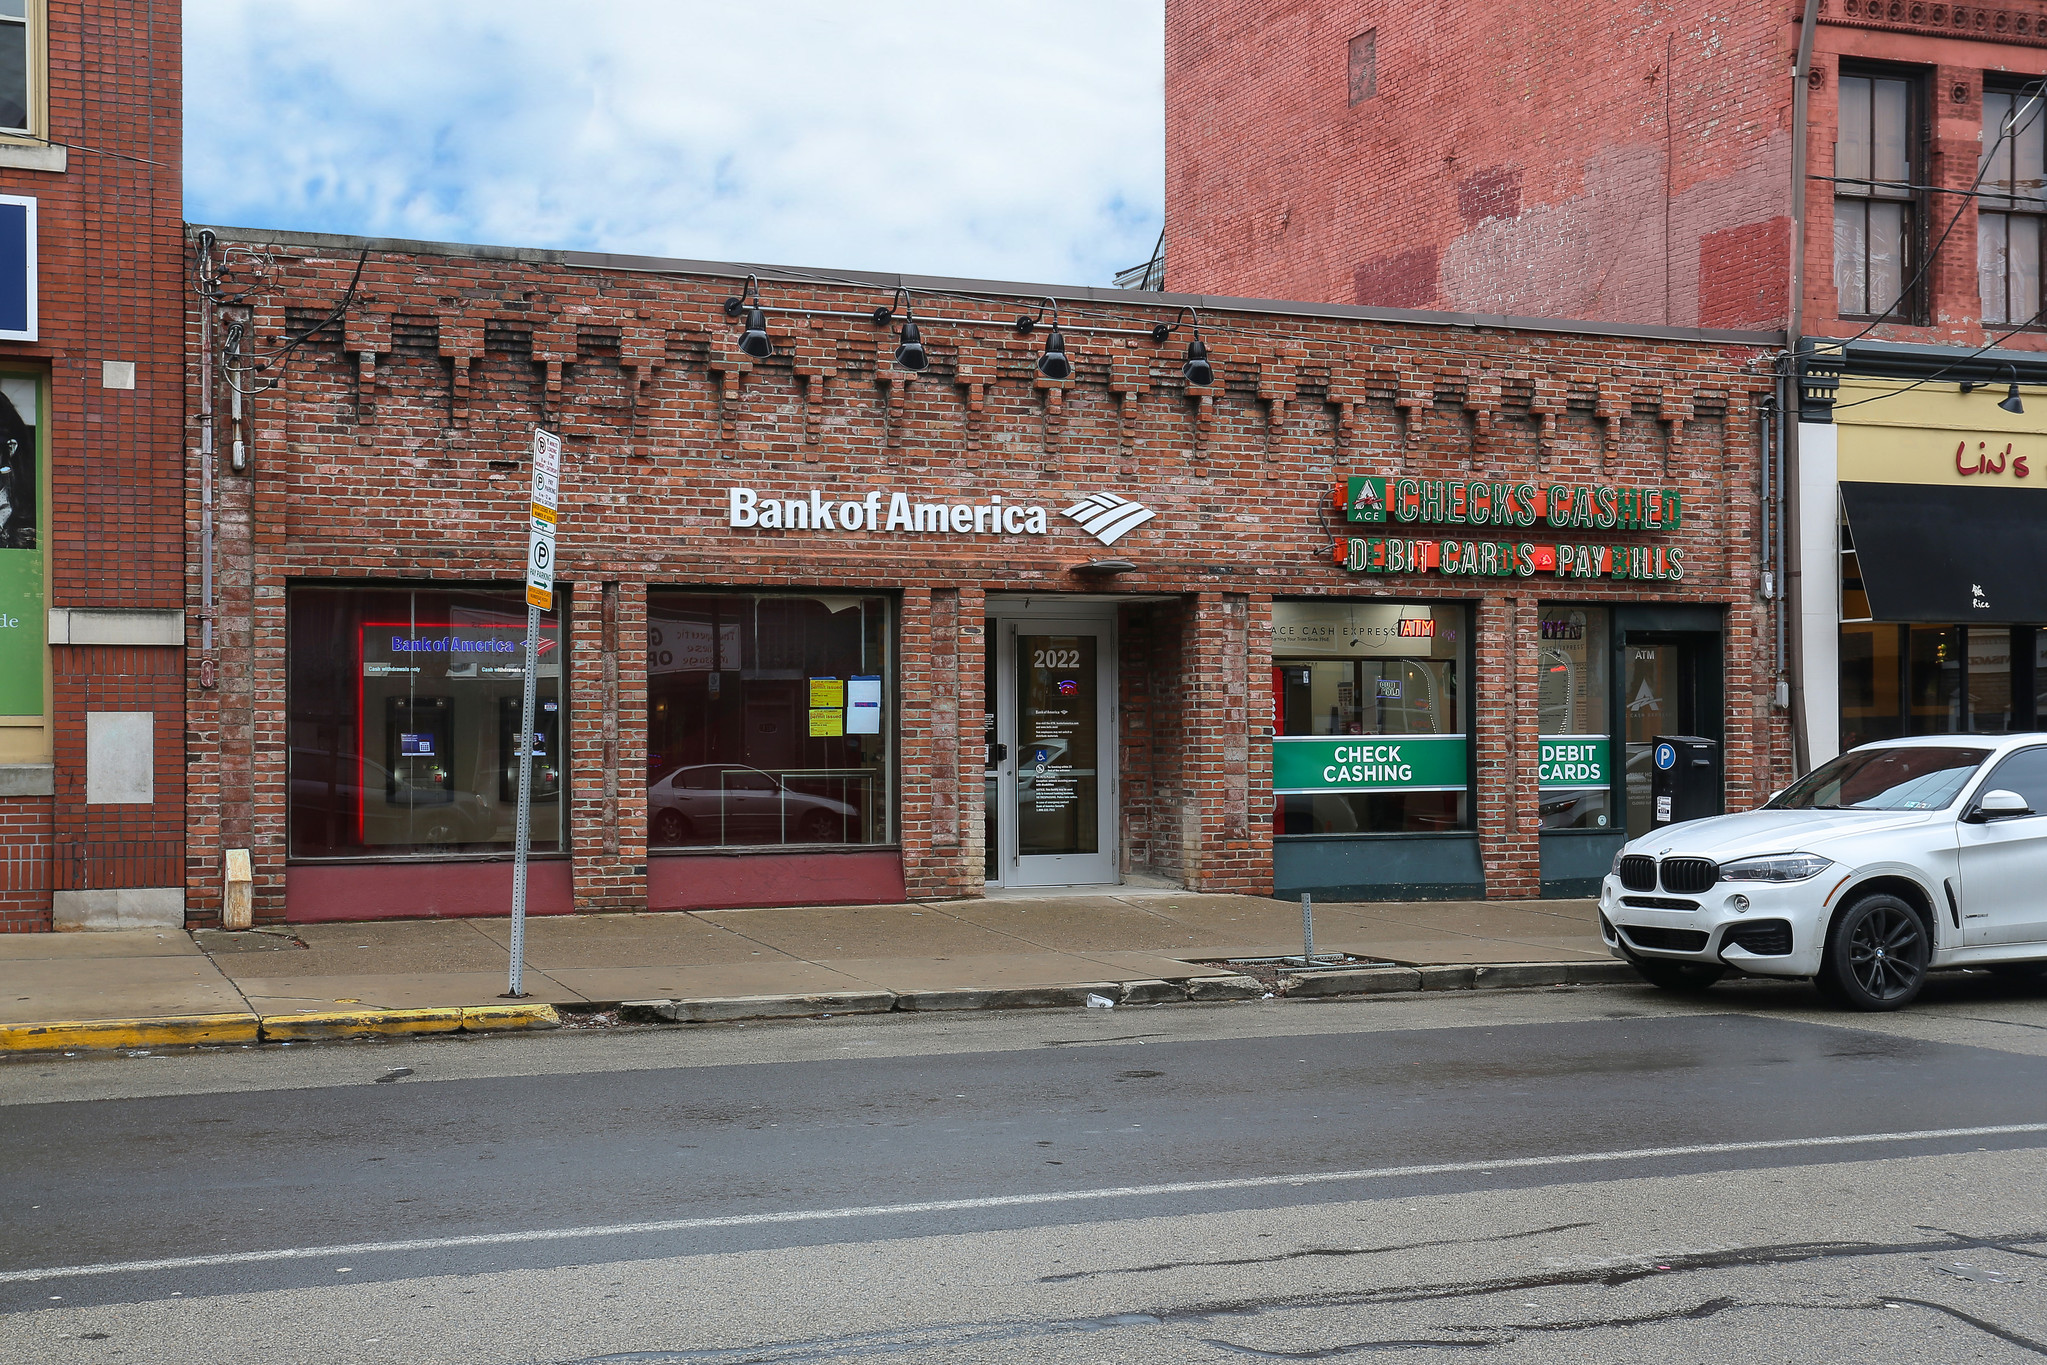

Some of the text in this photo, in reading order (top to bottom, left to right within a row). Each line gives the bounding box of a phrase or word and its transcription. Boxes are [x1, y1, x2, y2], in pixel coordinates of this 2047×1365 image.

[729, 487, 1047, 535] Bank of America
[1395, 478, 1682, 531] CHECKS CASHED
[1355, 511, 1380, 521] ACE
[1347, 537, 1684, 581] DEBIT CARDS PAY BILLS
[1972, 598, 1990, 609] Rice
[1302, 626, 1335, 636] CASH
[1342, 627, 1396, 636] EXPRESS
[1402, 619, 1435, 637] ATM
[391, 635, 514, 653] Bank of America
[1034, 649, 1080, 668] 2022
[1635, 650, 1655, 660] ATM
[1334, 745, 1402, 763] CHECK
[1542, 745, 1596, 762] DEBIT
[1323, 764, 1412, 783] CASHING
[1538, 763, 1601, 780] CARDS
